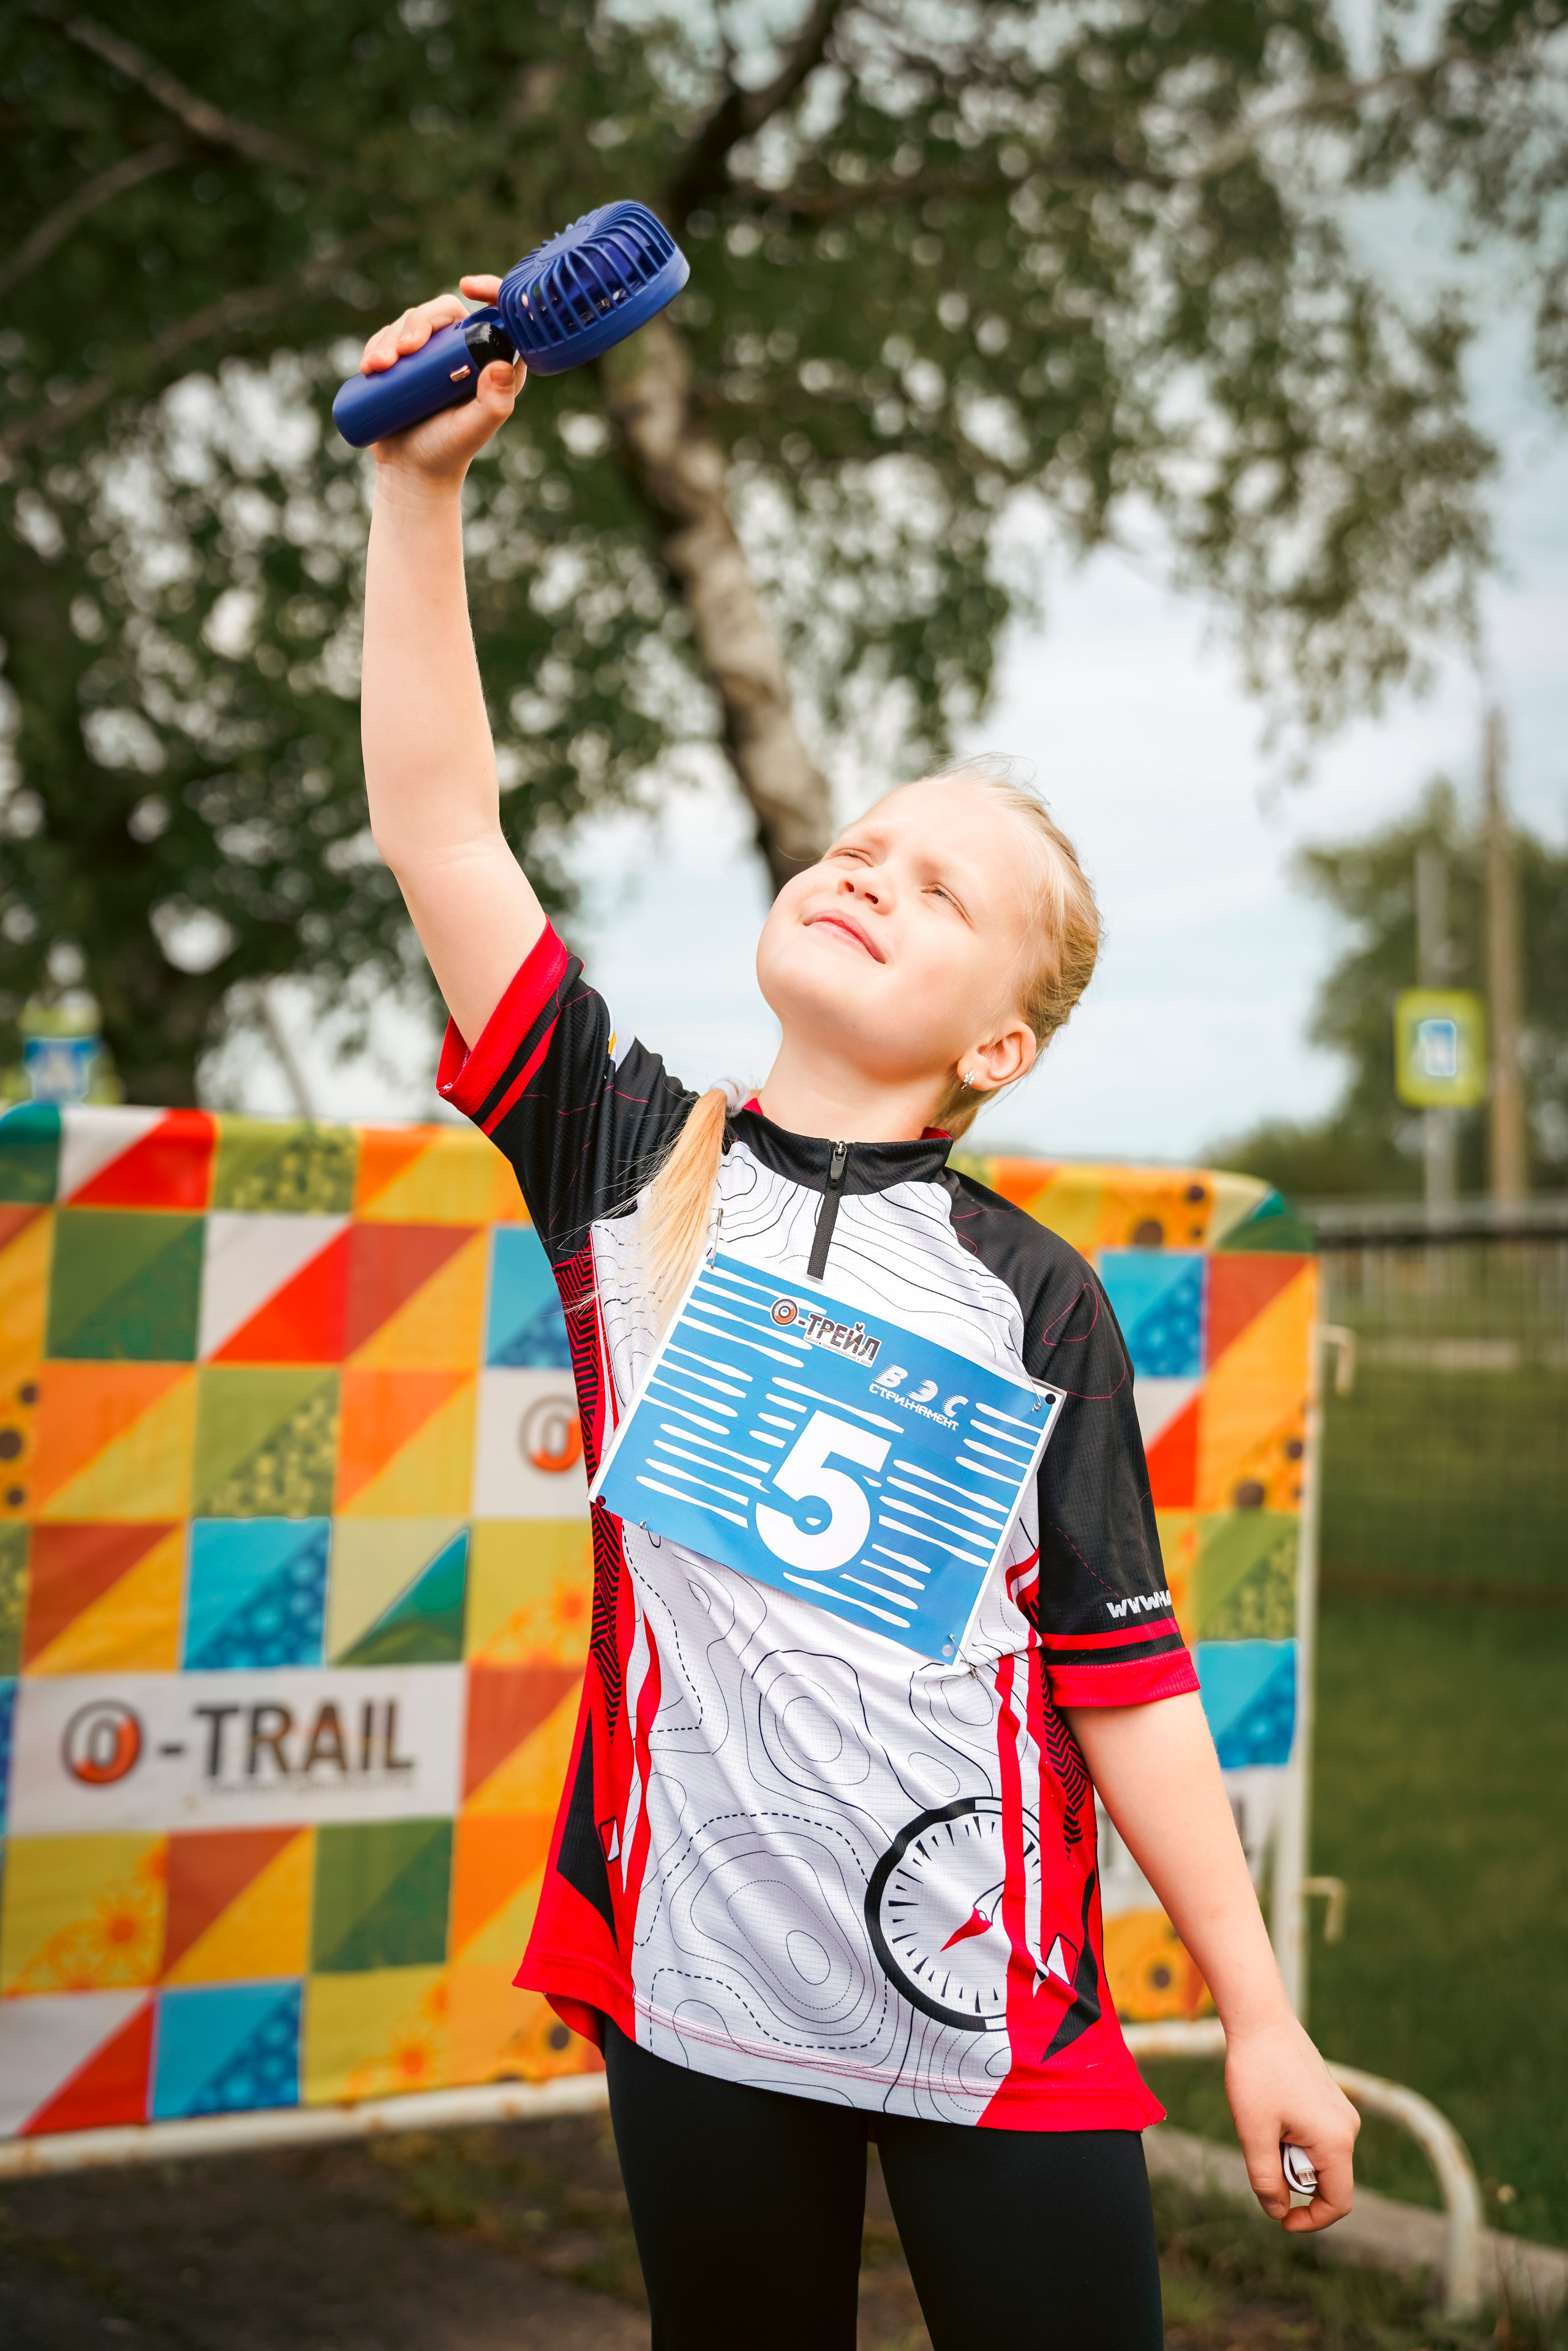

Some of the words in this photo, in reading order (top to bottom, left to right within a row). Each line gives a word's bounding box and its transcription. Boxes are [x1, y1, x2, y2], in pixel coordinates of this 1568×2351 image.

[804, 1335, 819, 1345] забеги
[821, 1343, 857, 1361] ориентирование
[869, 1383, 959, 1432] СТРИЖАМЕНТ
[755, 1409, 892, 1571] 5
